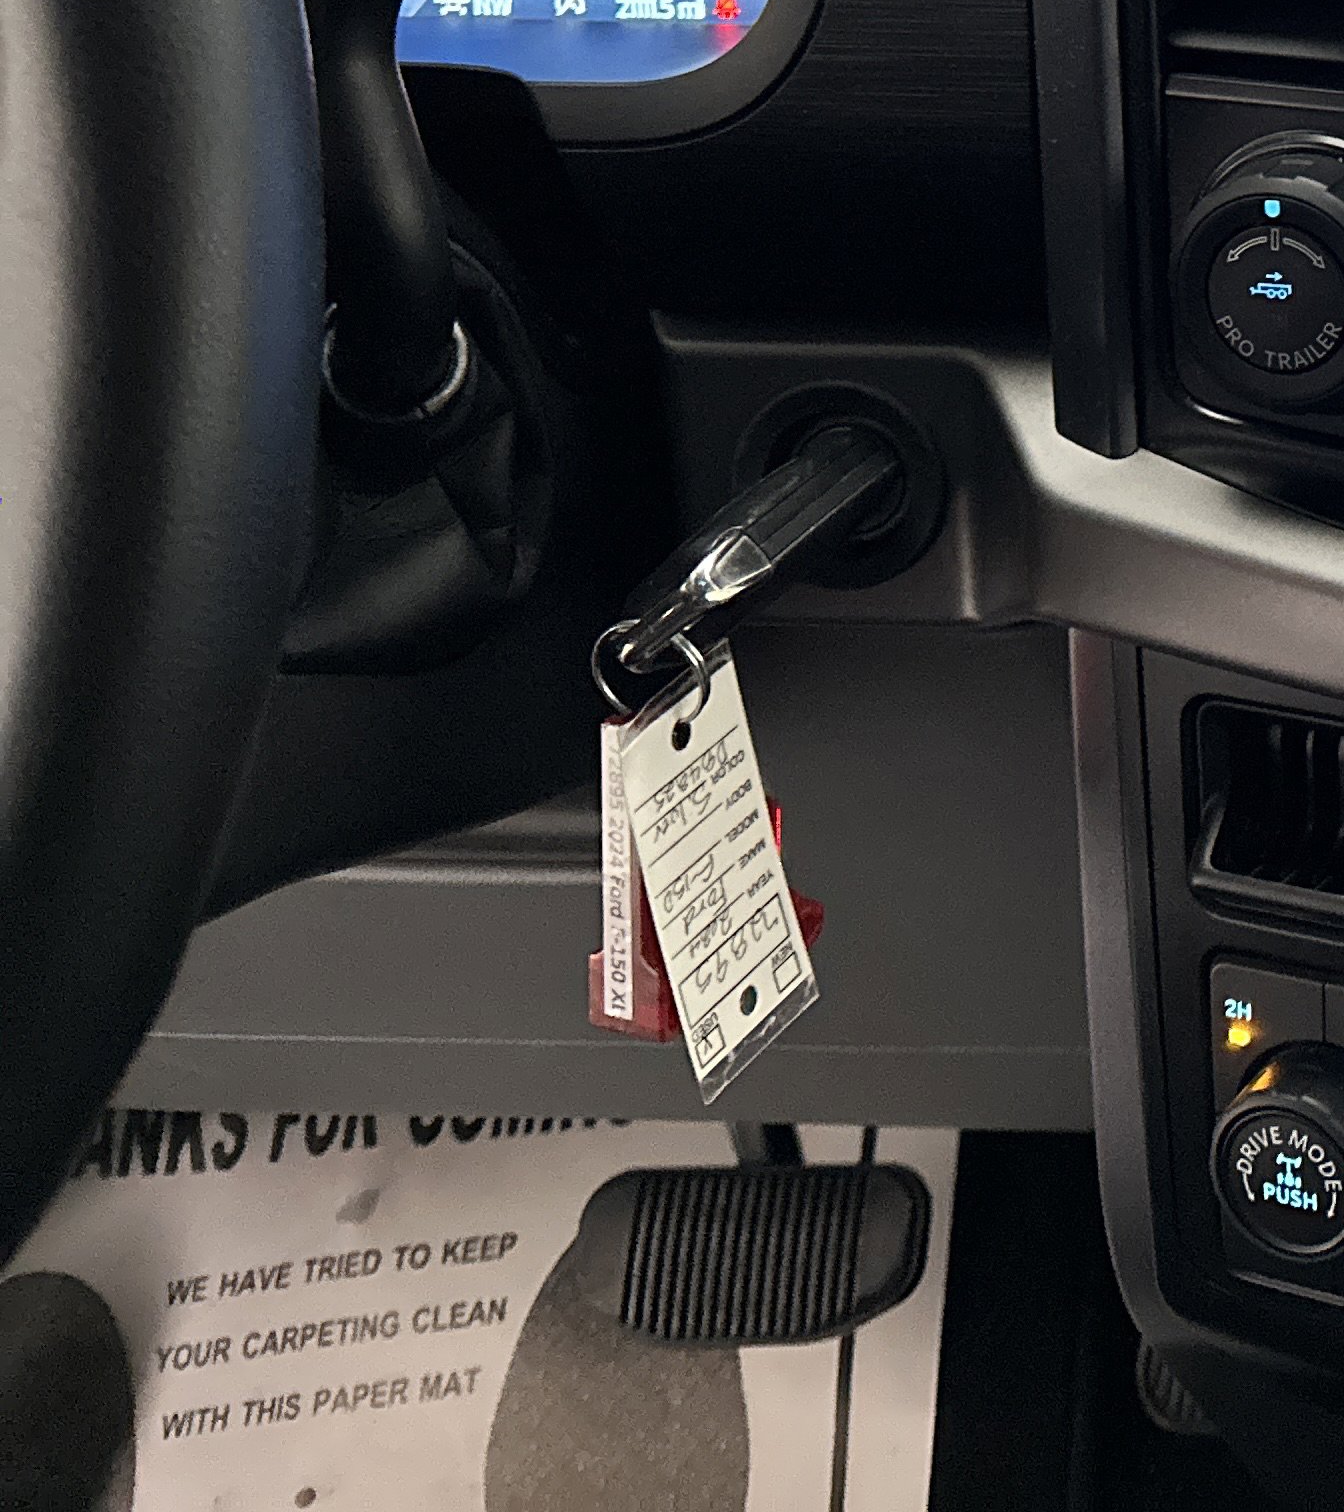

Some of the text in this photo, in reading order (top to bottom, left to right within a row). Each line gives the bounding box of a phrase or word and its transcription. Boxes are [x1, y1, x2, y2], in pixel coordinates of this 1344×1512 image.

[1215, 315, 1343, 370] PRO TRAILER
[710, 749, 745, 785] COLOR
[725, 778, 753, 811] BODY
[724, 808, 760, 843] MODEL
[738, 837, 767, 869] MAKE
[609, 875, 626, 919] Ford
[747, 868, 775, 898] YEAR
[1223, 998, 1253, 1021] 2H
[1236, 1125, 1343, 1192] DRIVE MODE
[1262, 1182, 1319, 1212] PUSH
[166, 1231, 519, 1306] WE HAVE TRIED TO KEEP
[155, 1296, 509, 1374] YOUR CARPETING CLEAN
[161, 1365, 482, 1441] WITH THIS PAPER MAT
